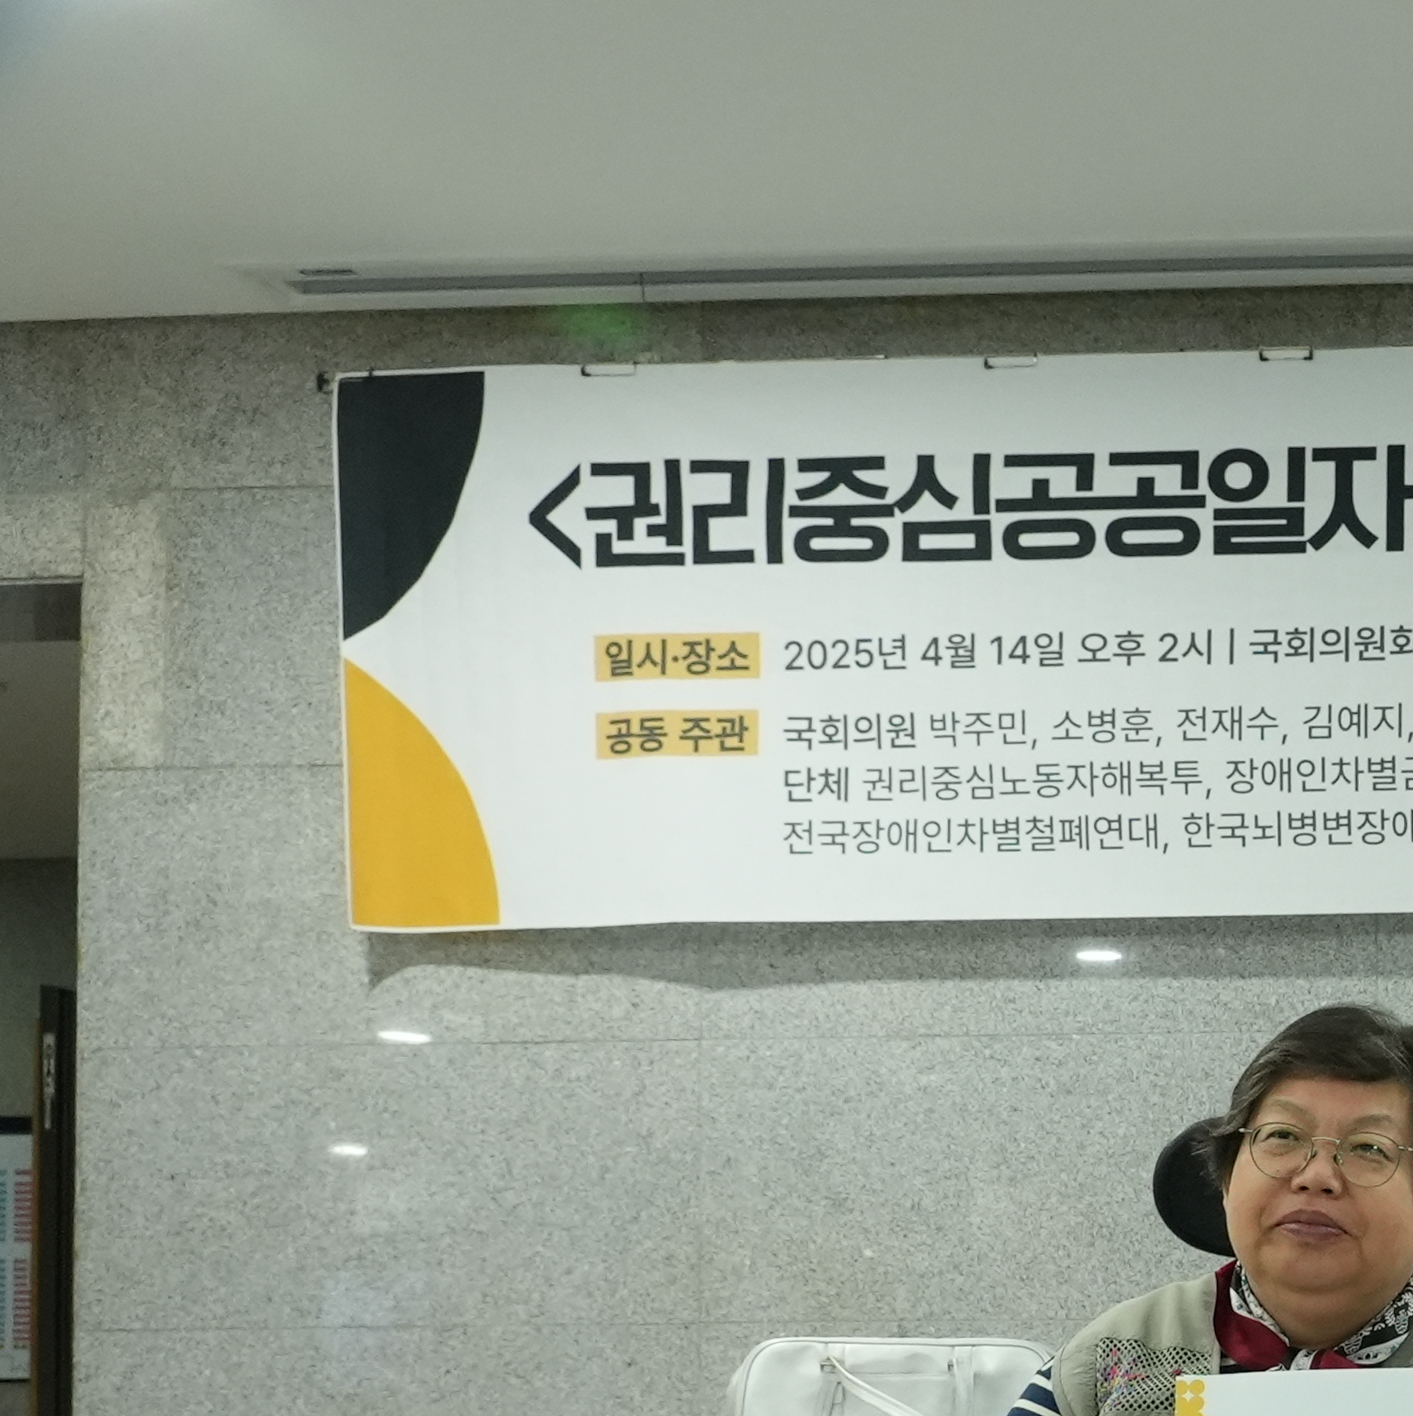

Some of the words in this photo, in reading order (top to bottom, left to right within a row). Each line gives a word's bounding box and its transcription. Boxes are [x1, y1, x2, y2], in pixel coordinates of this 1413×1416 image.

[785, 634, 906, 670] 2025년
[921, 633, 975, 668] 4월
[991, 632, 1064, 667] 14일
[1078, 631, 1145, 666] 오후
[1159, 629, 1211, 664] 2시
[606, 717, 668, 755] 공동
[679, 715, 749, 753] 주관
[784, 712, 916, 750] 국회의원
[930, 710, 1037, 750] 박주민,
[1052, 708, 1161, 747] 소병훈,
[1178, 706, 1287, 745] 전재수,
[1304, 703, 1413, 742] 김예지,
[785, 767, 848, 802] 단체
[864, 761, 1211, 801] 권리중심노동자해복투,
[784, 813, 1168, 854] 전국장애인차별철폐연대,
